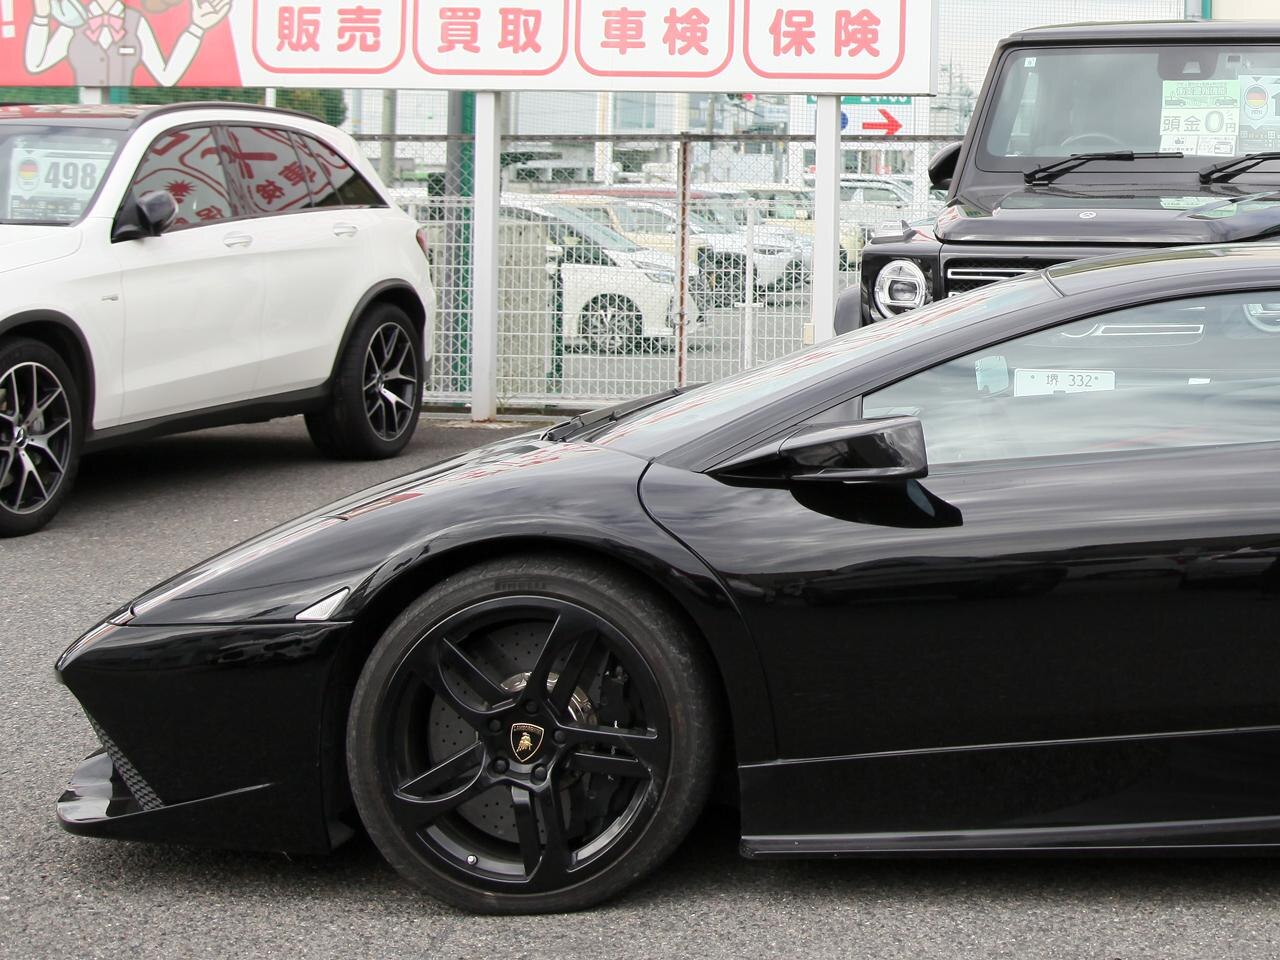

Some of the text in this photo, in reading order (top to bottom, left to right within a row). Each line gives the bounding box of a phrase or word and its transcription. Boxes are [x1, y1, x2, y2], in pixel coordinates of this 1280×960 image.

[276, 6, 881, 58] 販売 買取 車検 保険
[44, 161, 97, 190] 498
[1068, 374, 1093, 387] 332
